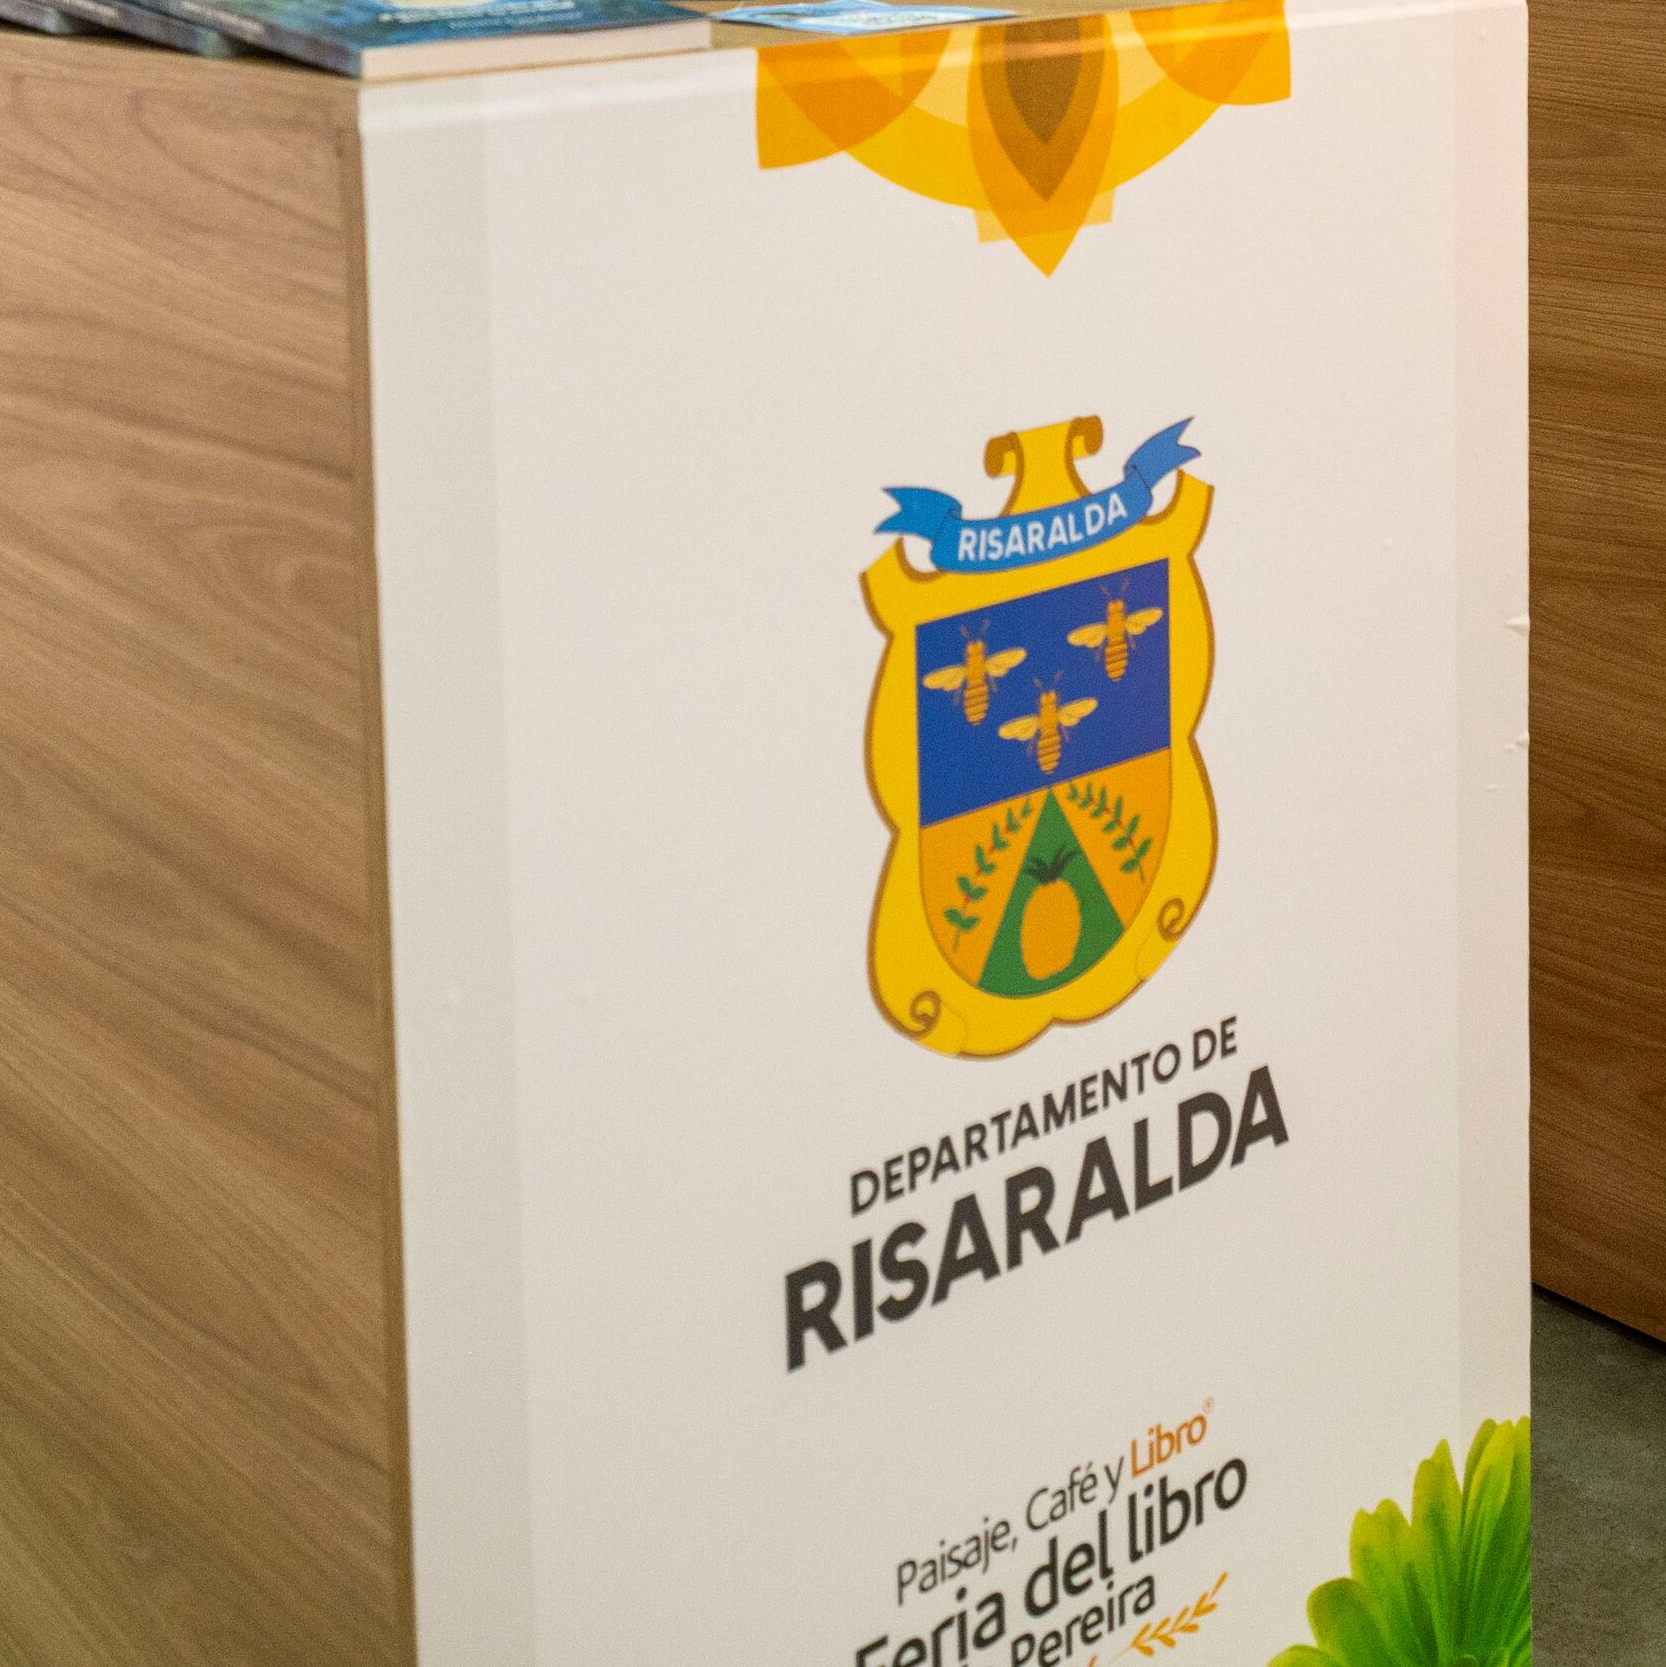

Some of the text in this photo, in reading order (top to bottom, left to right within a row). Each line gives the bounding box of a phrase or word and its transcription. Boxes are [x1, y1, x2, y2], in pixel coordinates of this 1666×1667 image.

[956, 493, 1130, 564] RISARALDA
[849, 1015, 1239, 1217] DEPARTAMENTO DE
[784, 1064, 1290, 1374] RISARALDA
[895, 1517, 1018, 1606] Paisaje,
[1025, 1460, 1099, 1532] Café
[1103, 1456, 1124, 1505] y
[1023, 1509, 1114, 1618] del
[1128, 1457, 1248, 1564] libro
